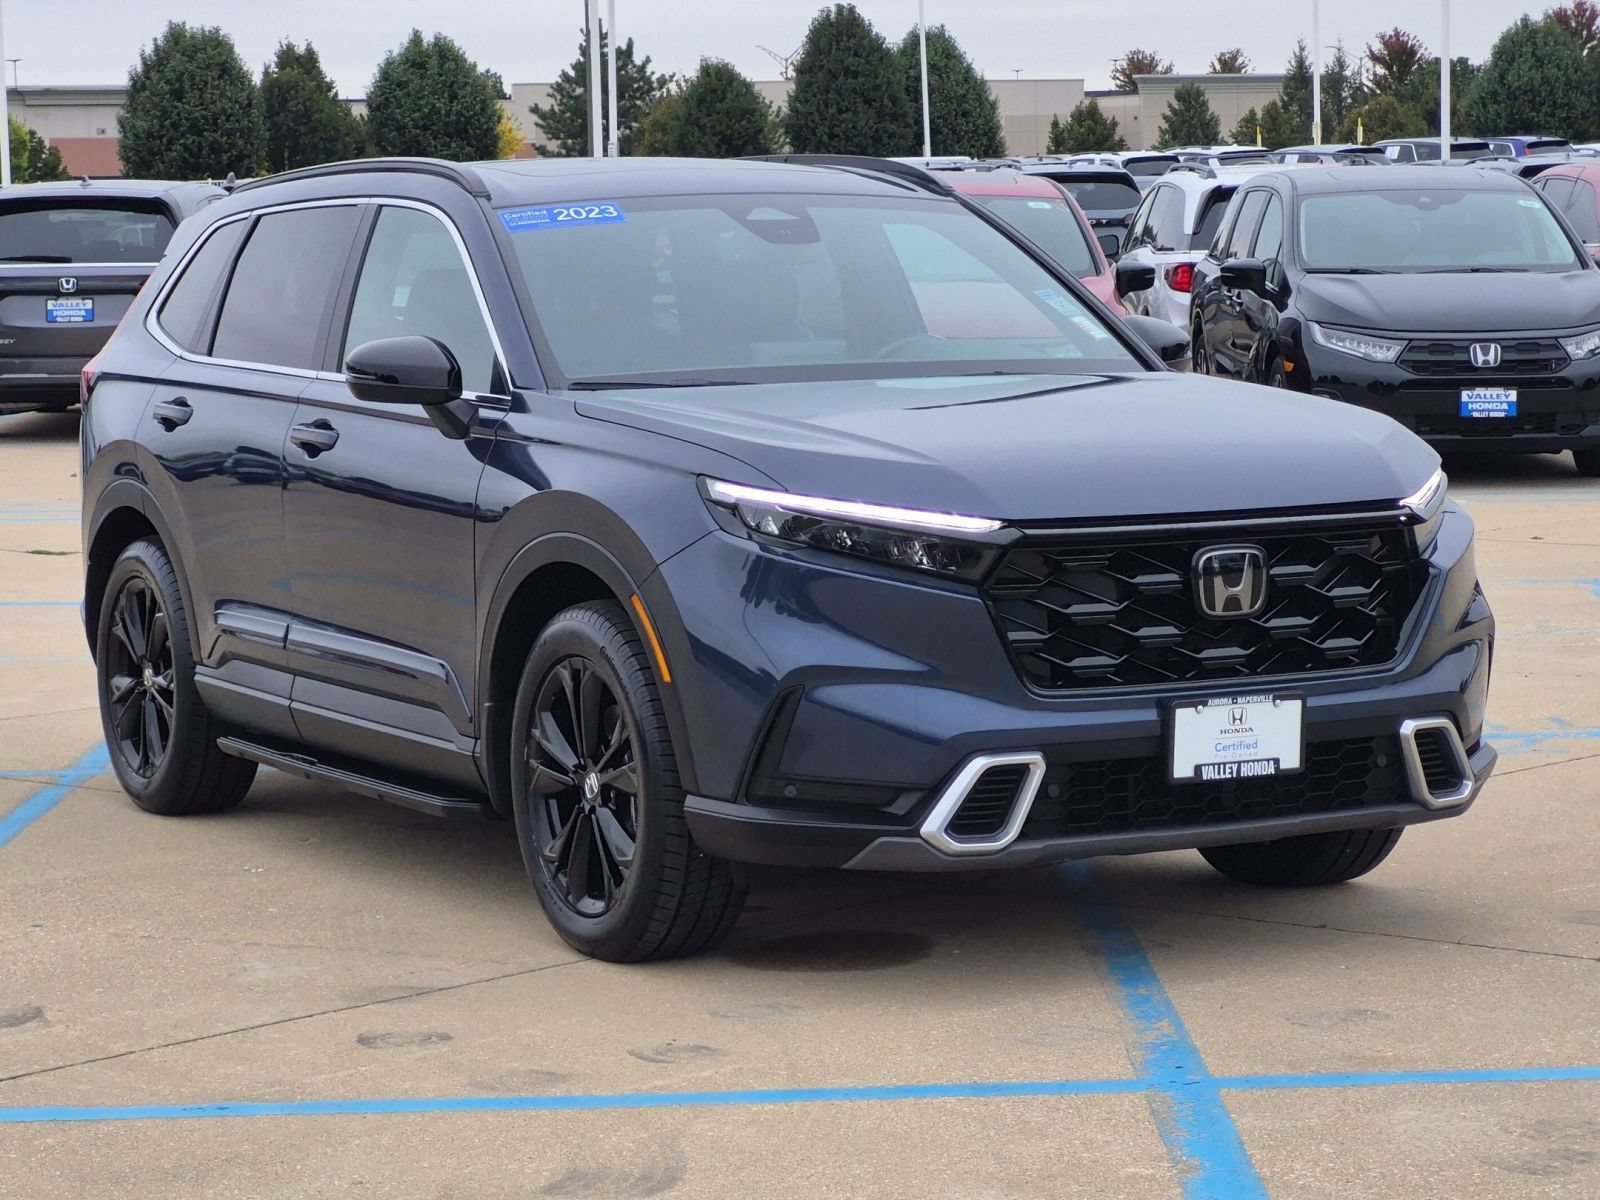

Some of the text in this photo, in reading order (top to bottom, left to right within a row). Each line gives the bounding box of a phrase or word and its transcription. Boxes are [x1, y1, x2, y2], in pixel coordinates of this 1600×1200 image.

[553, 205, 618, 220] 2023
[1468, 402, 1509, 410] HONDA
[1219, 726, 1254, 735] HONDA
[1214, 739, 1258, 752] Certified
[1201, 759, 1276, 780] VALLEY HONDA
